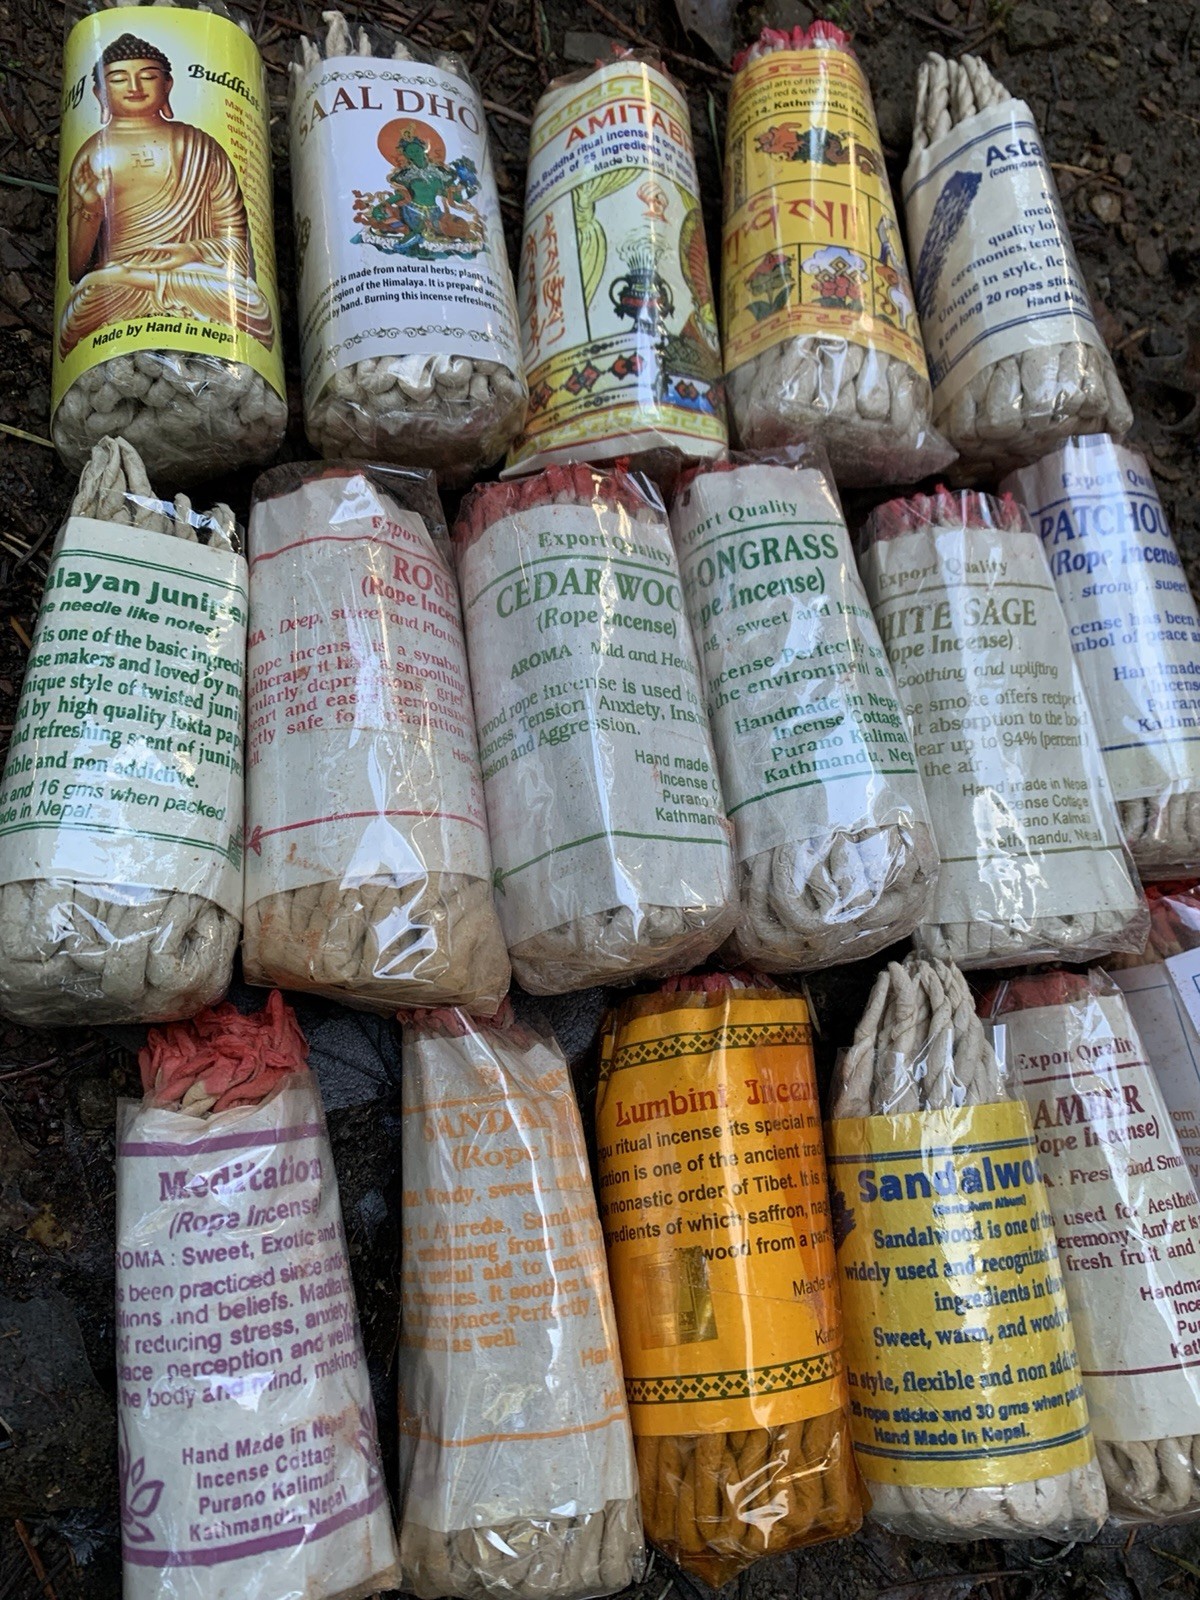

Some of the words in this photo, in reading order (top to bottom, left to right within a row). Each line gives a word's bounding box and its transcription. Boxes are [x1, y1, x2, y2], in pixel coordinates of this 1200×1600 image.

[774, 80, 791, 89] arts
[794, 78, 804, 86] of
[774, 89, 789, 98] red
[542, 152, 575, 181] Buddha
[577, 136, 603, 155] ritual
[607, 129, 648, 142] incense
[626, 155, 639, 165] by
[986, 139, 1041, 167] Asta
[570, 161, 579, 172] of
[348, 269, 372, 281] made
[374, 266, 394, 276] from
[396, 264, 428, 274] natural
[951, 244, 1026, 287] ceremonies,
[356, 282, 364, 293] of
[366, 280, 380, 290] the
[383, 278, 427, 287] Himalaya.
[428, 278, 435, 287] It
[437, 279, 444, 287] is
[446, 281, 483, 295] prepared
[939, 285, 979, 323] Unique
[983, 274, 998, 286] in
[986, 292, 1002, 306] 20
[1005, 281, 1043, 298] ropas
[341, 299, 363, 312] hand.
[365, 291, 399, 304] Burning
[402, 291, 418, 300] this
[420, 292, 452, 301] incense
[1027, 292, 1060, 308] Hand
[92, 328, 122, 348] Made
[126, 323, 142, 337] by
[146, 322, 181, 335] Hand
[185, 324, 197, 336] in
[728, 501, 798, 521] Quality
[361, 575, 415, 606] (Rope
[393, 555, 458, 607] ROSE
[496, 568, 600, 618] CEDAR
[729, 567, 825, 608] Incense)
[1155, 578, 1188, 593] sweet
[60, 601, 122, 616] needle
[127, 606, 160, 623] like
[536, 608, 598, 634] (Rope
[736, 612, 789, 636] sweet
[964, 598, 1037, 626] SAGE
[1165, 611, 1195, 626] been
[43, 626, 55, 642] is
[58, 628, 88, 642] one
[92, 627, 112, 643] of
[114, 629, 141, 648] the
[146, 636, 188, 659] basic
[290, 641, 360, 663] incense
[54, 648, 115, 670] makers
[118, 657, 149, 674] and
[154, 661, 199, 685] loved
[203, 672, 223, 695] by
[510, 645, 572, 679] AROMA
[629, 651, 658, 664] and
[70, 672, 113, 694] style
[285, 698, 317, 717] and
[510, 691, 538, 724] rope
[622, 678, 636, 692] is
[642, 682, 681, 700] used
[599, 696, 665, 720] Anxiety,
[715, 686, 740, 709] the
[995, 689, 1038, 704] offers
[32, 696, 50, 717] by
[57, 696, 98, 719] high
[103, 703, 167, 730] quality
[287, 714, 323, 734] safe
[735, 694, 840, 734] Handmade
[772, 710, 845, 740] Incense
[929, 712, 1022, 738] absorption
[1029, 713, 1041, 724] to
[1045, 712, 1062, 725] the
[33, 719, 122, 748] refreshing
[177, 741, 194, 756] of
[511, 736, 535, 759] and
[771, 736, 842, 761] Purano
[1002, 732, 1037, 746] 94%
[36, 751, 68, 769] and
[634, 750, 670, 766] Hand
[674, 758, 708, 771] made
[924, 761, 952, 777] the
[659, 771, 708, 790] Incense
[10, 783, 34, 800] and
[39, 780, 59, 793] 16
[63, 783, 104, 800] gms
[110, 788, 159, 808] when
[19, 802, 31, 818] in
[616, 1084, 728, 1126] Lumbini
[616, 1134, 652, 1154] ritual
[657, 1125, 722, 1146] incense
[755, 1114, 804, 1135] special
[634, 1166, 647, 1179] is
[653, 1163, 682, 1177] one
[688, 1154, 703, 1171] of
[709, 1152, 738, 1167] the
[744, 1143, 800, 1163] ancient
[158, 1156, 322, 1201] Meditation
[611, 1192, 673, 1214] monastic
[678, 1183, 726, 1203] order
[731, 1179, 749, 1195] of
[754, 1173, 797, 1193] Tibet.
[666, 1218, 683, 1235] of
[688, 1211, 742, 1233] which
[748, 1203, 809, 1224] saffron,
[1064, 1205, 1106, 1226] used
[988, 1221, 1001, 1238] is
[1005, 1220, 1027, 1236] one
[182, 1241, 254, 1266] Sweet,
[261, 1230, 313, 1255] Exotic
[508, 1235, 554, 1254] from
[756, 1235, 795, 1253] from
[800, 1235, 807, 1247] a
[1066, 1253, 1112, 1272] fresh
[1121, 1247, 1161, 1266] fruit
[1167, 1240, 1197, 1257] and
[522, 1260, 541, 1274] to
[896, 1260, 938, 1280] used
[944, 1255, 975, 1277] and
[129, 1283, 173, 1302] been
[180, 1267, 275, 1302] practiced
[280, 1260, 321, 1282] since
[218, 1292, 293, 1320] beliefs.
[230, 1318, 299, 1345] stress,
[873, 1326, 931, 1349] Sweet,
[998, 1316, 1026, 1339] and
[168, 1347, 283, 1383] perception
[291, 1336, 323, 1359] and
[903, 1370, 975, 1392] flexible
[980, 1365, 1012, 1388] and
[1018, 1363, 1047, 1381] non
[149, 1385, 195, 1407] body
[943, 1403, 971, 1422] and
[182, 1443, 228, 1465] Hand
[236, 1433, 284, 1457] Made
[291, 1426, 306, 1444] in
[874, 1428, 910, 1445] Hand
[914, 1427, 958, 1445] Made
[962, 1427, 977, 1443] in
[197, 1463, 269, 1489] Incense
[199, 1490, 265, 1514] Purano
